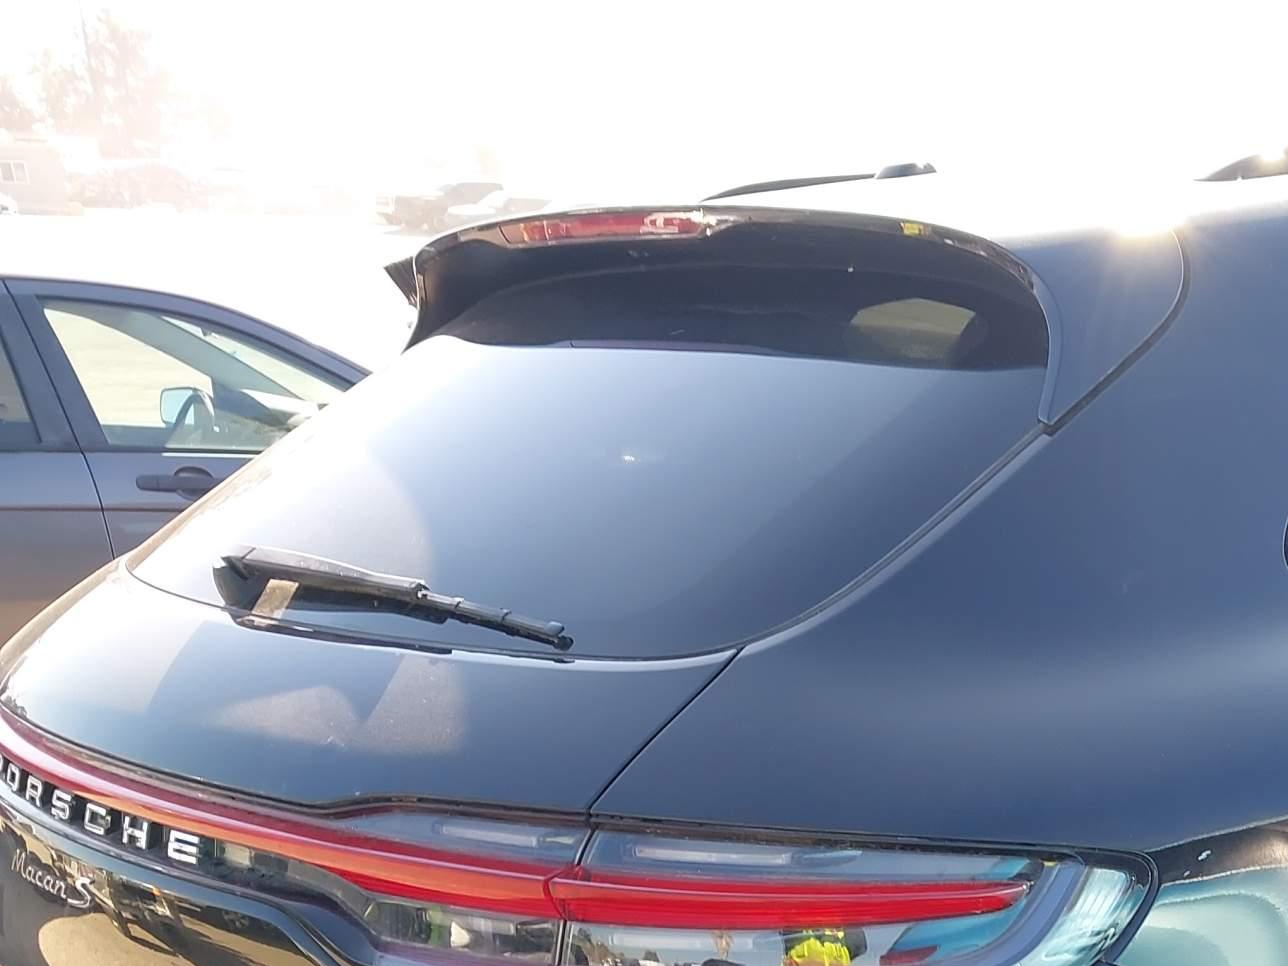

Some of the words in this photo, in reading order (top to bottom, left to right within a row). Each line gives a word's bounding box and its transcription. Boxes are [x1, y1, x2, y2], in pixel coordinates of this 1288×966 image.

[0, 754, 201, 865] ORSCHE
[11, 849, 67, 899] Macan
[67, 876, 95, 909] S
